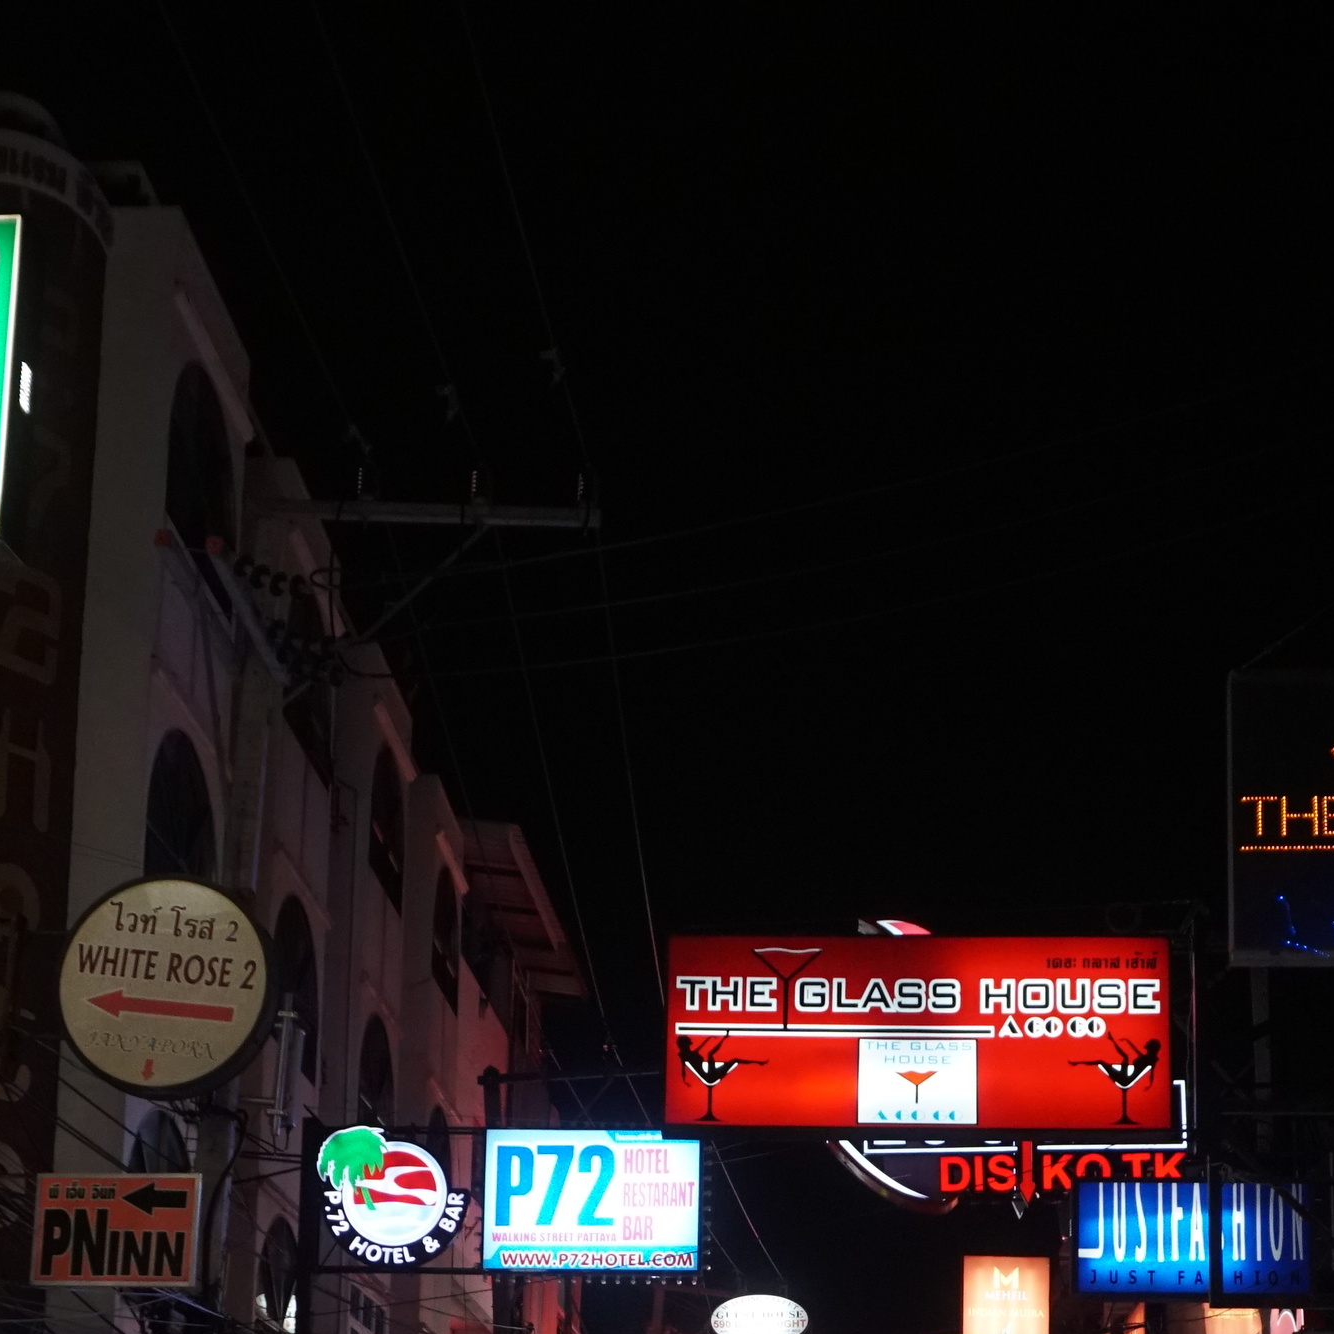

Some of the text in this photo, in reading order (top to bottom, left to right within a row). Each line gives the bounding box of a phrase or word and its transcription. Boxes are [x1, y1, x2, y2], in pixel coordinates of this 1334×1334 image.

[110, 900, 239, 943] ไวท์ โรส 2
[78, 943, 257, 990] WHITE ROSE 2
[675, 976, 1162, 1016] THE GLASS HOUSE
[866, 1041, 973, 1051] THE GLASS
[884, 1054, 951, 1065] HOUSE
[624, 1148, 670, 1174] HOTEL
[495, 1145, 615, 1226] P72
[623, 1181, 695, 1207] RESTARANT
[348, 1235, 417, 1265] HOTEL
[422, 1236, 441, 1254] &
[437, 1191, 466, 1234] BAR
[492, 1231, 617, 1242] WALKING STREET PATTAYA
[622, 1215, 654, 1241] BAR
[502, 1253, 693, 1267] WWW.P72HOTEL.COM
[1090, 1269, 1301, 1287] JUST FAHION
[985, 1289, 1028, 1301] MEHFIL
